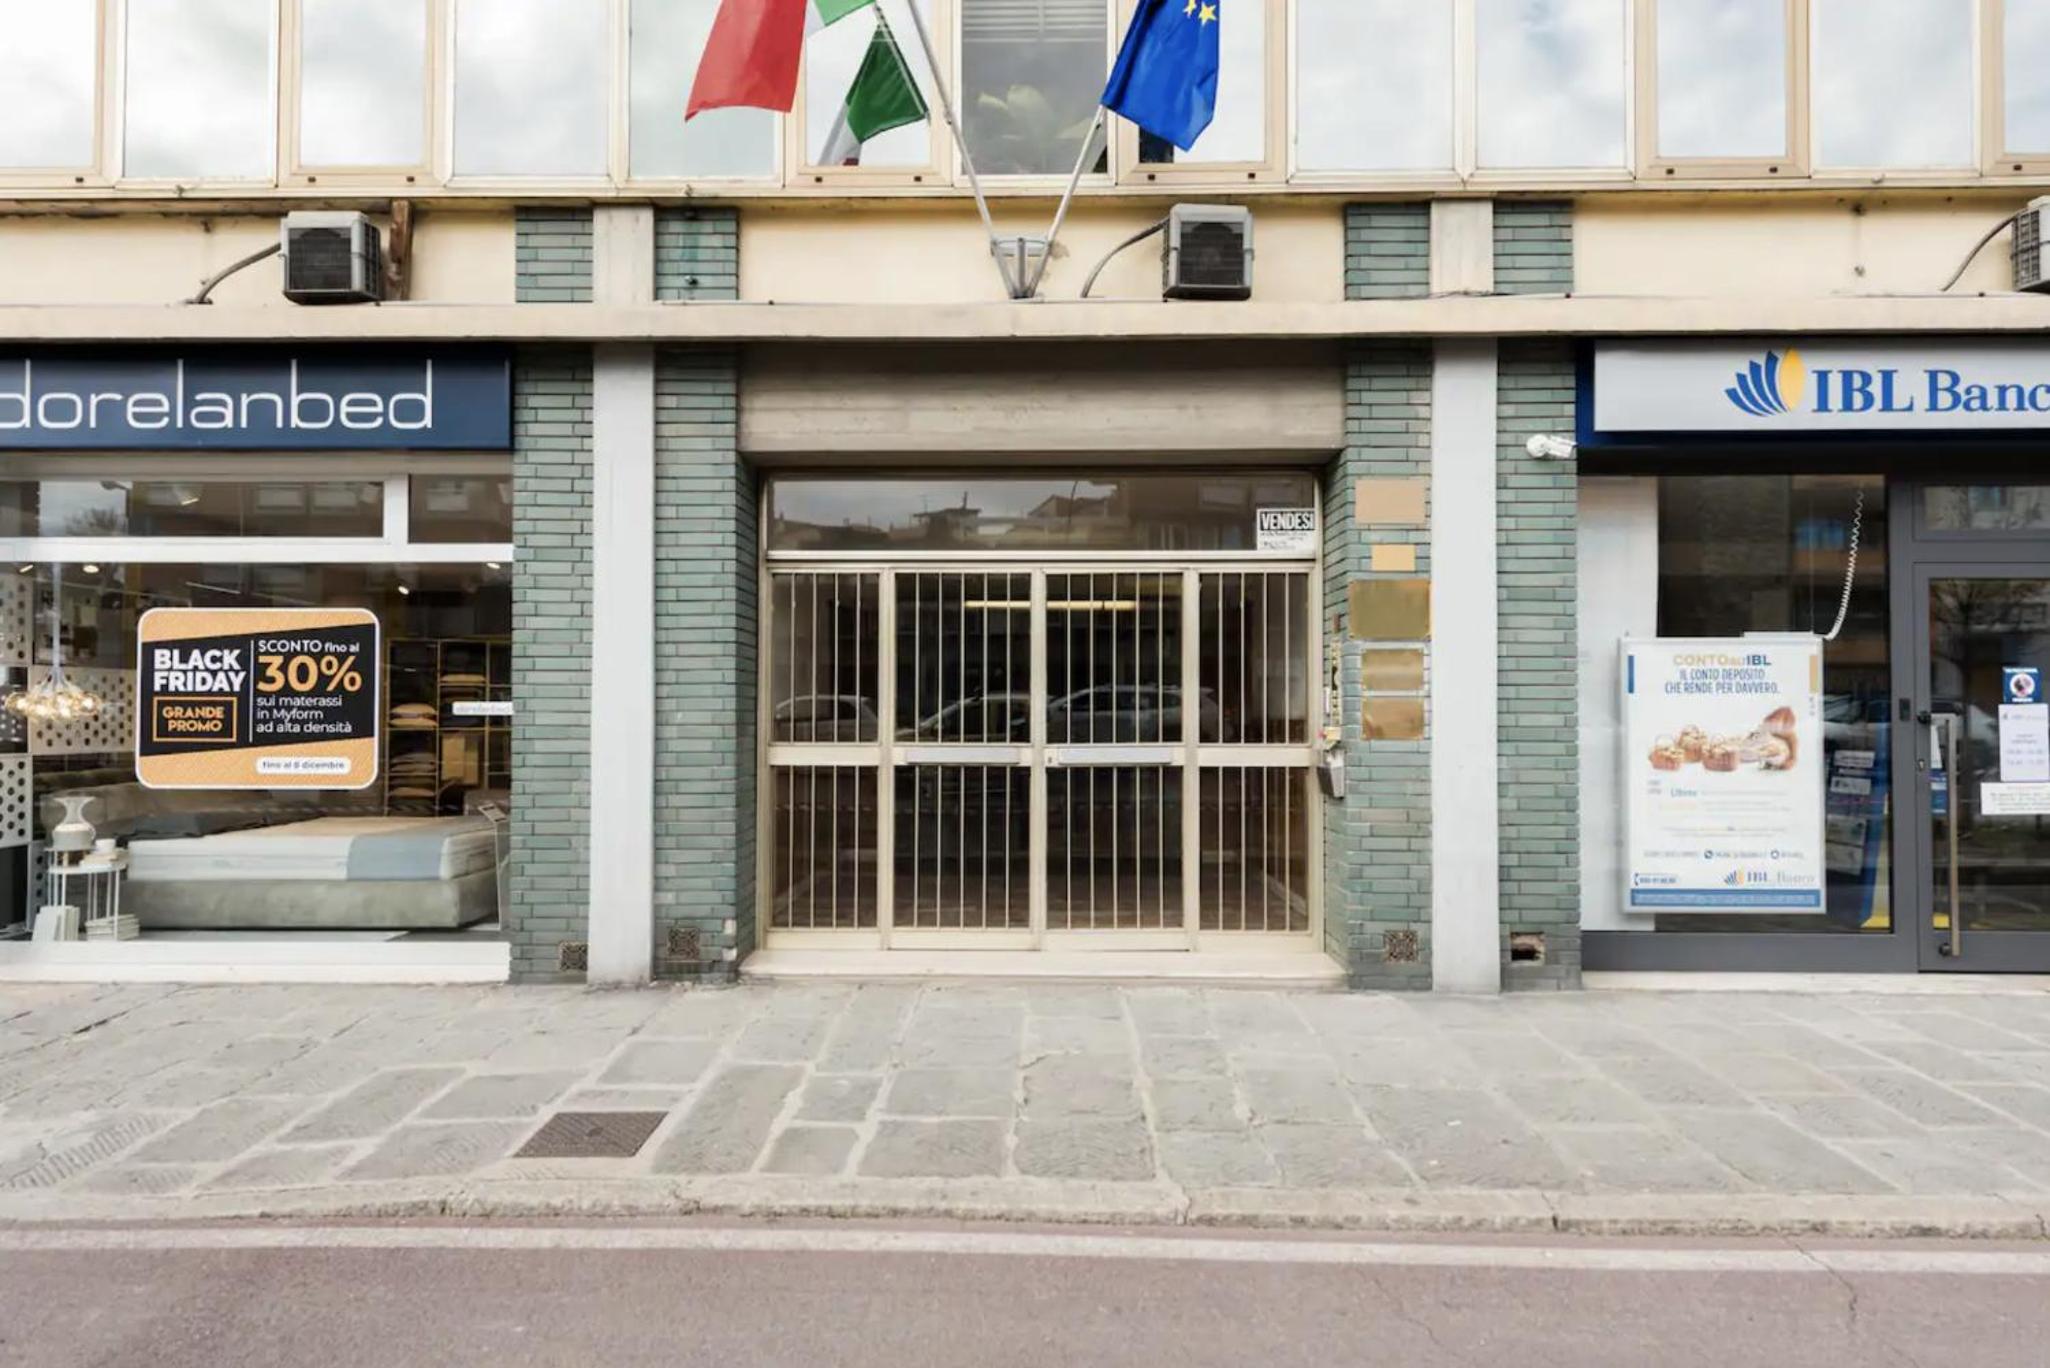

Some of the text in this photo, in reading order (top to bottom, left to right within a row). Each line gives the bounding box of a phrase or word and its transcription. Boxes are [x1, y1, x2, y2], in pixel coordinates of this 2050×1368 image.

[0, 359, 434, 429] dorelanbed
[1811, 368, 2050, 413] IBL Banc
[1260, 512, 1313, 530] VENDESI
[257, 639, 360, 653] SCONTO fino al
[153, 648, 242, 671] BLACK
[256, 655, 363, 693] 30%
[1690, 668, 1720, 680] CONTO
[1721, 668, 1766, 680] DEPOSITO
[153, 671, 247, 693] FRIDAY
[1664, 682, 1683, 694] CHE
[1684, 682, 1713, 694] RENDE
[1715, 682, 1734, 694] PER
[256, 694, 343, 707] sui materassi
[162, 706, 225, 719] GRANDE
[256, 707, 325, 724] in Myform
[167, 719, 223, 732] PROMO
[256, 720, 353, 733] ad alta densità
[262, 760, 281, 769] fino
[302, 760, 345, 769] dicembre
